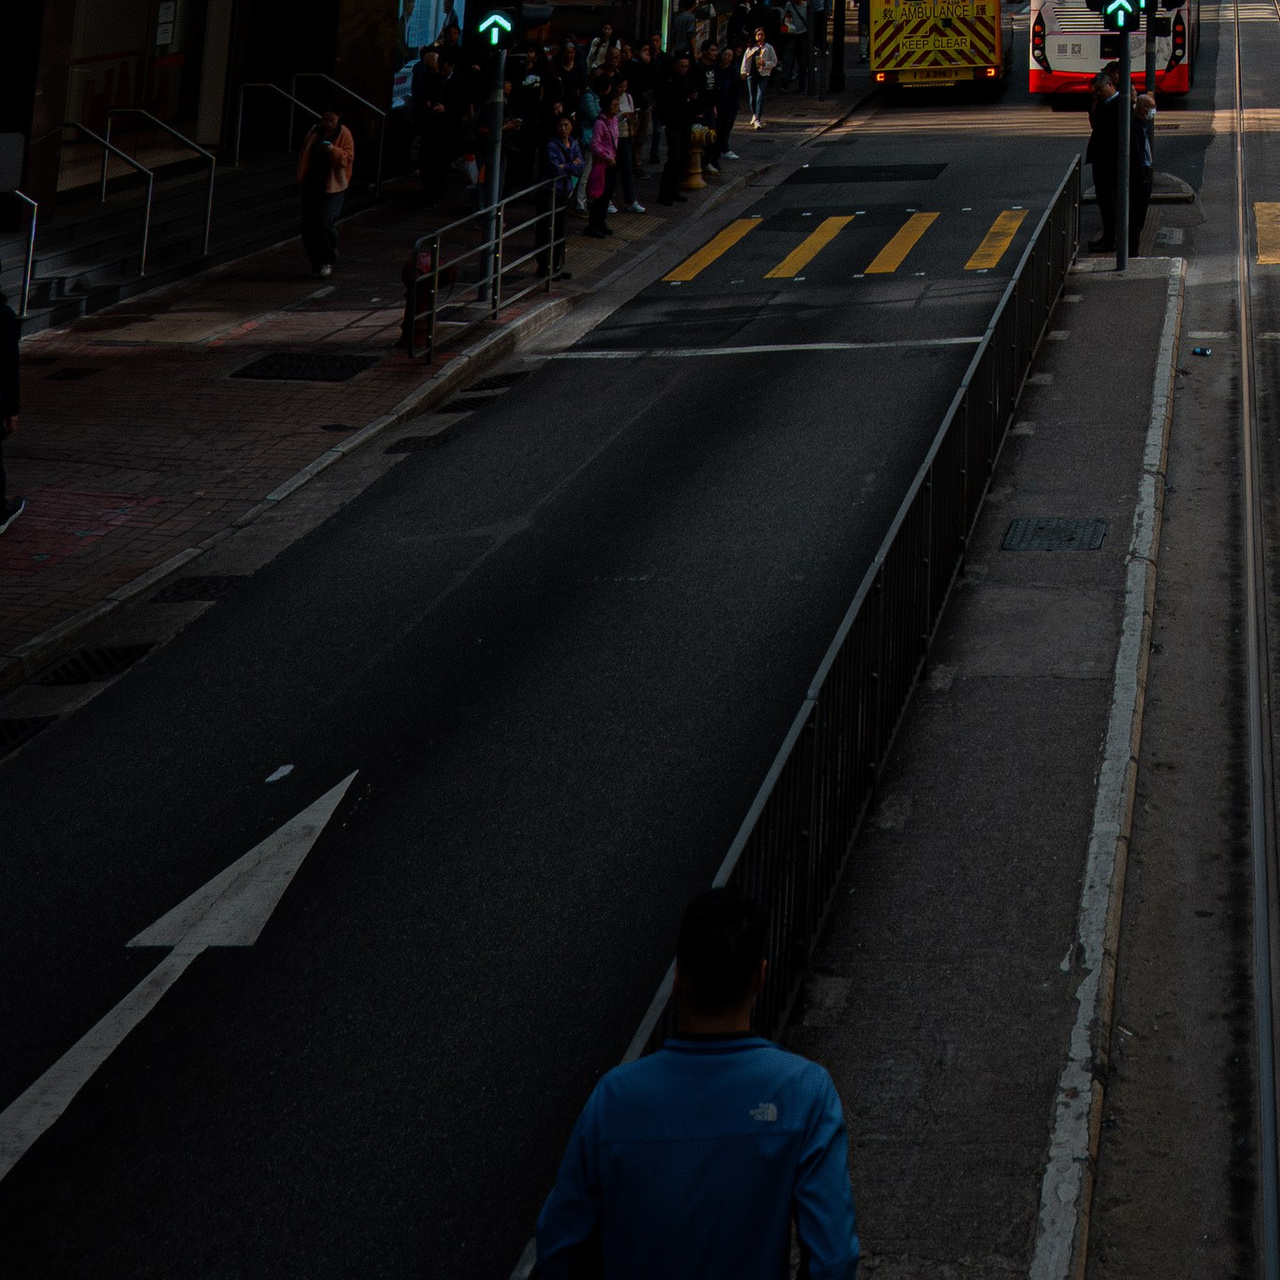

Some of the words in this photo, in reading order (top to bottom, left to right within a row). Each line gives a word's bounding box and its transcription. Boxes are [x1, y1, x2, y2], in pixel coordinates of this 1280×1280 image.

[900, 4, 970, 19] AMBULANCE
[901, 40, 930, 50] KEEP
[933, 37, 968, 49] CLEAR
